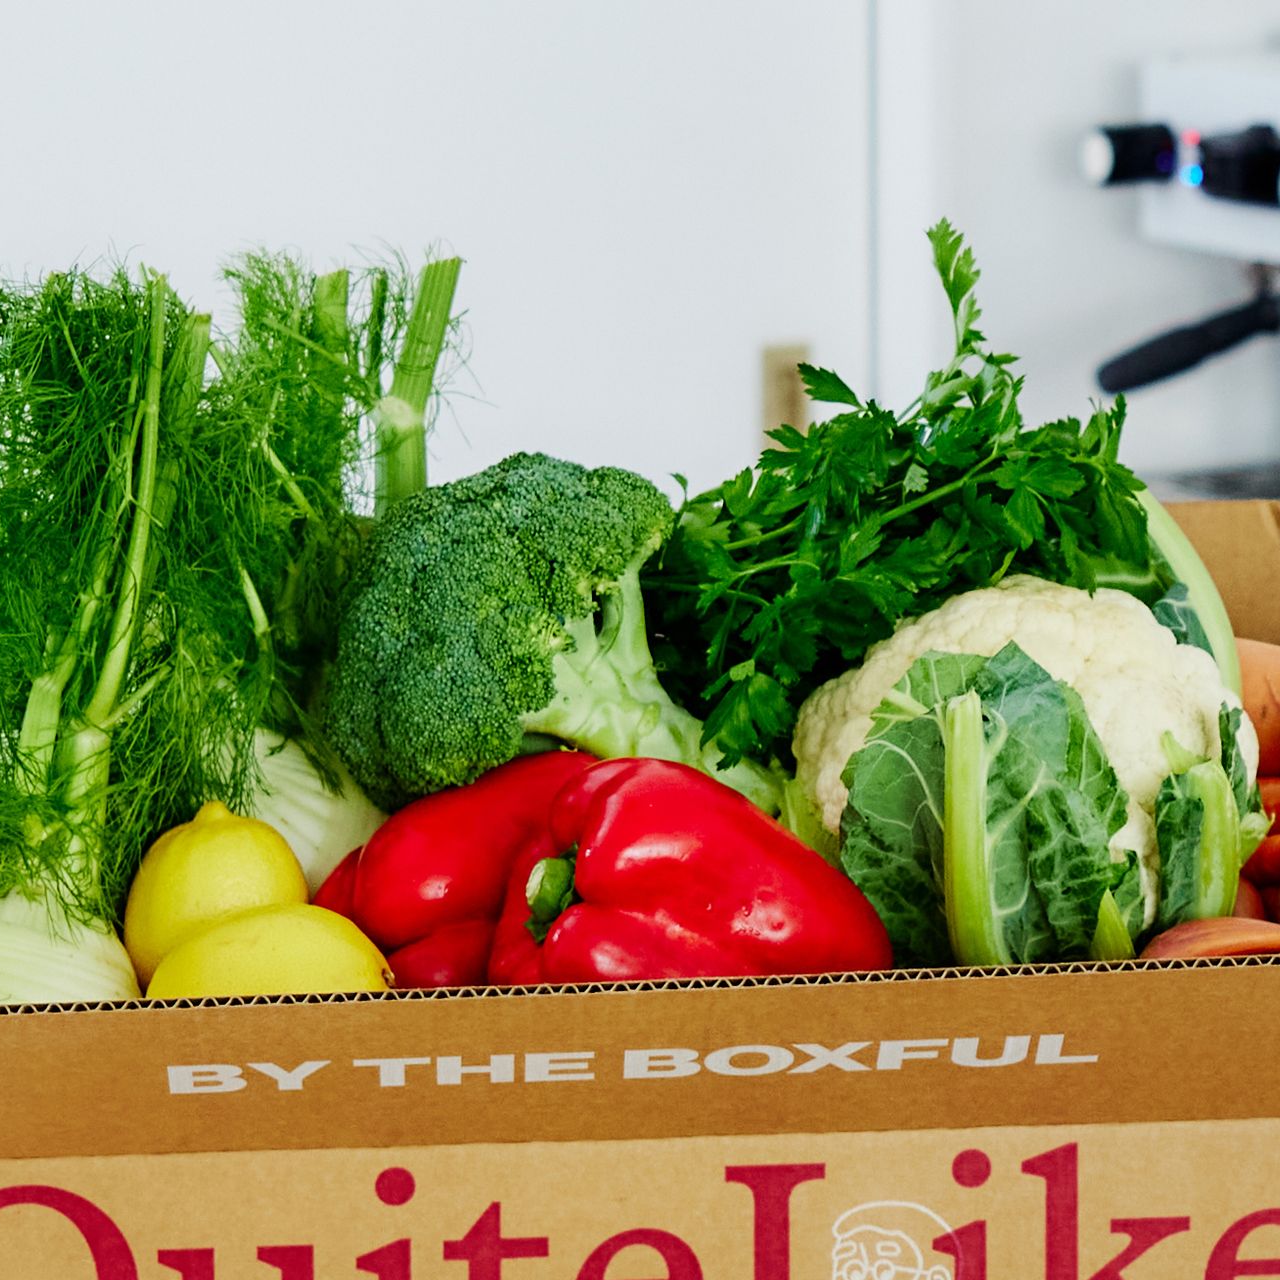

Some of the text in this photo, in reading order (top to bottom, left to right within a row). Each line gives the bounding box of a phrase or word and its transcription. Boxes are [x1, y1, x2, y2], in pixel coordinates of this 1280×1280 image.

[167, 1033, 1099, 1095] BY THE BOXFUL
